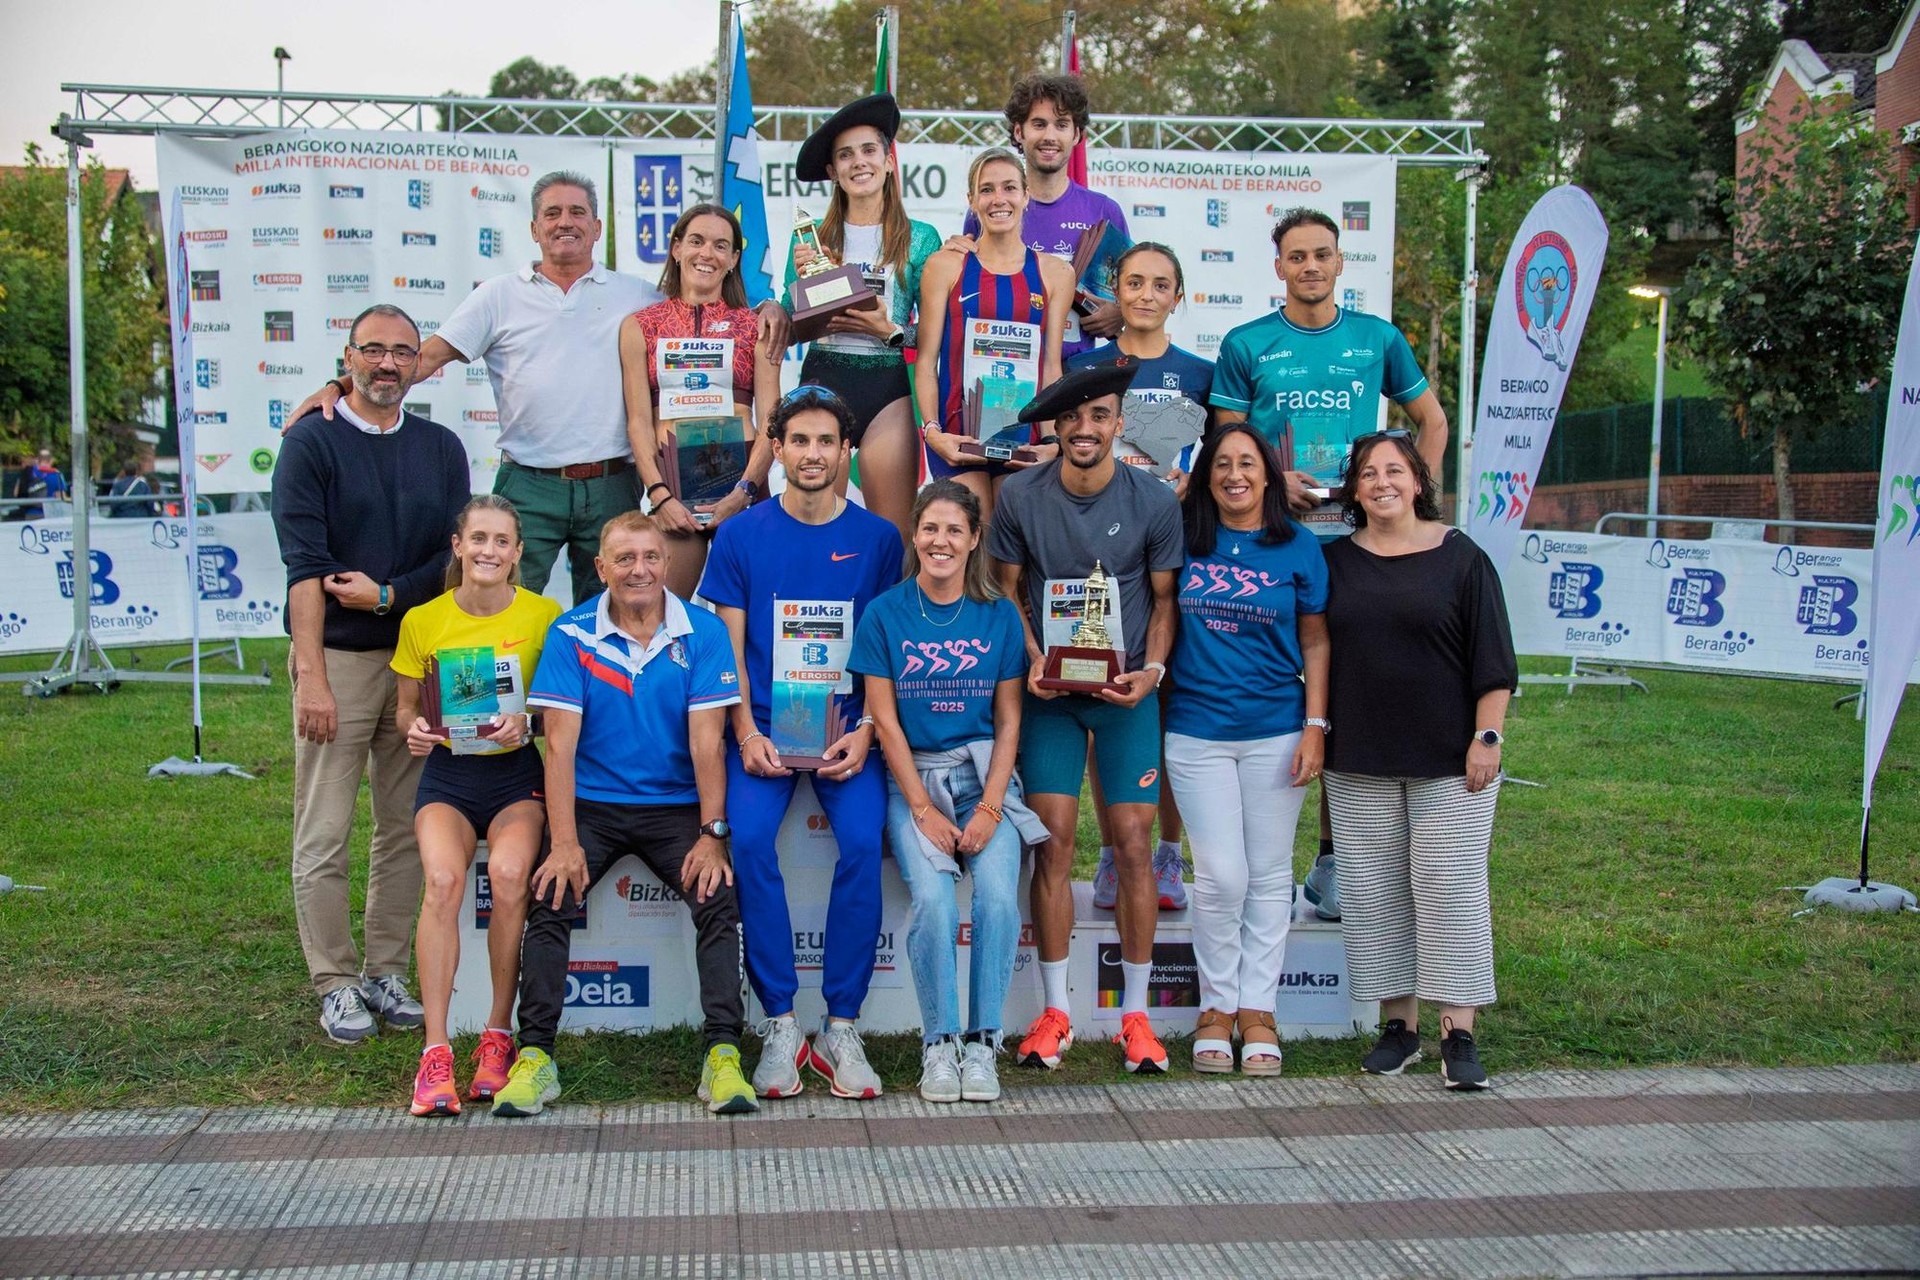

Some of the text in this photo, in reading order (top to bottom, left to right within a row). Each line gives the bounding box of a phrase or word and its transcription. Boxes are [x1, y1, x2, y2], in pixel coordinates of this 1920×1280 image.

[244, 139, 518, 161] BERANGOKO NAZIOARTEKO MILIA
[235, 154, 530, 177] MILLA INTERNACIONAL DE BERANGO
[1153, 161, 1266, 177] NAZIOARTEKO
[1269, 164, 1312, 177] MILIA
[264, 182, 301, 195] sukia
[1091, 174, 1322, 192] INTERNACIONAL DE BERANGO
[181, 185, 229, 196] EUSKADI
[476, 190, 516, 203] Bizkaia
[252, 227, 299, 237] EUSKADI
[1067, 222, 1091, 231] UCL
[194, 231, 226, 240] EROSKI
[337, 228, 373, 239] sukia
[327, 274, 369, 284] EUSKADI
[409, 277, 445, 290] sukia
[1207, 292, 1243, 305] sukia
[191, 321, 231, 333] Bizkaia
[990, 324, 1032, 338] sukia
[682, 341, 724, 351] sukia
[265, 364, 303, 376] Bizkaia
[683, 396, 721, 404] EROSKI
[1275, 389, 1351, 411] Facsa
[1504, 434, 1532, 450] MILIA
[216, 608, 272, 625] Berango
[800, 604, 844, 617] sukia
[90, 615, 153, 629] Berango
[1205, 619, 1239, 634] 2025
[1565, 627, 1622, 646] Berango
[1684, 634, 1746, 656] Berango
[1815, 643, 1870, 666] Berang
[801, 672, 839, 680] EROSKI
[931, 701, 965, 712] 2025
[629, 883, 682, 902] Bizka
[1151, 963, 1198, 972] trucciones
[1149, 973, 1185, 983] daburu
[1278, 971, 1339, 987] sukia
